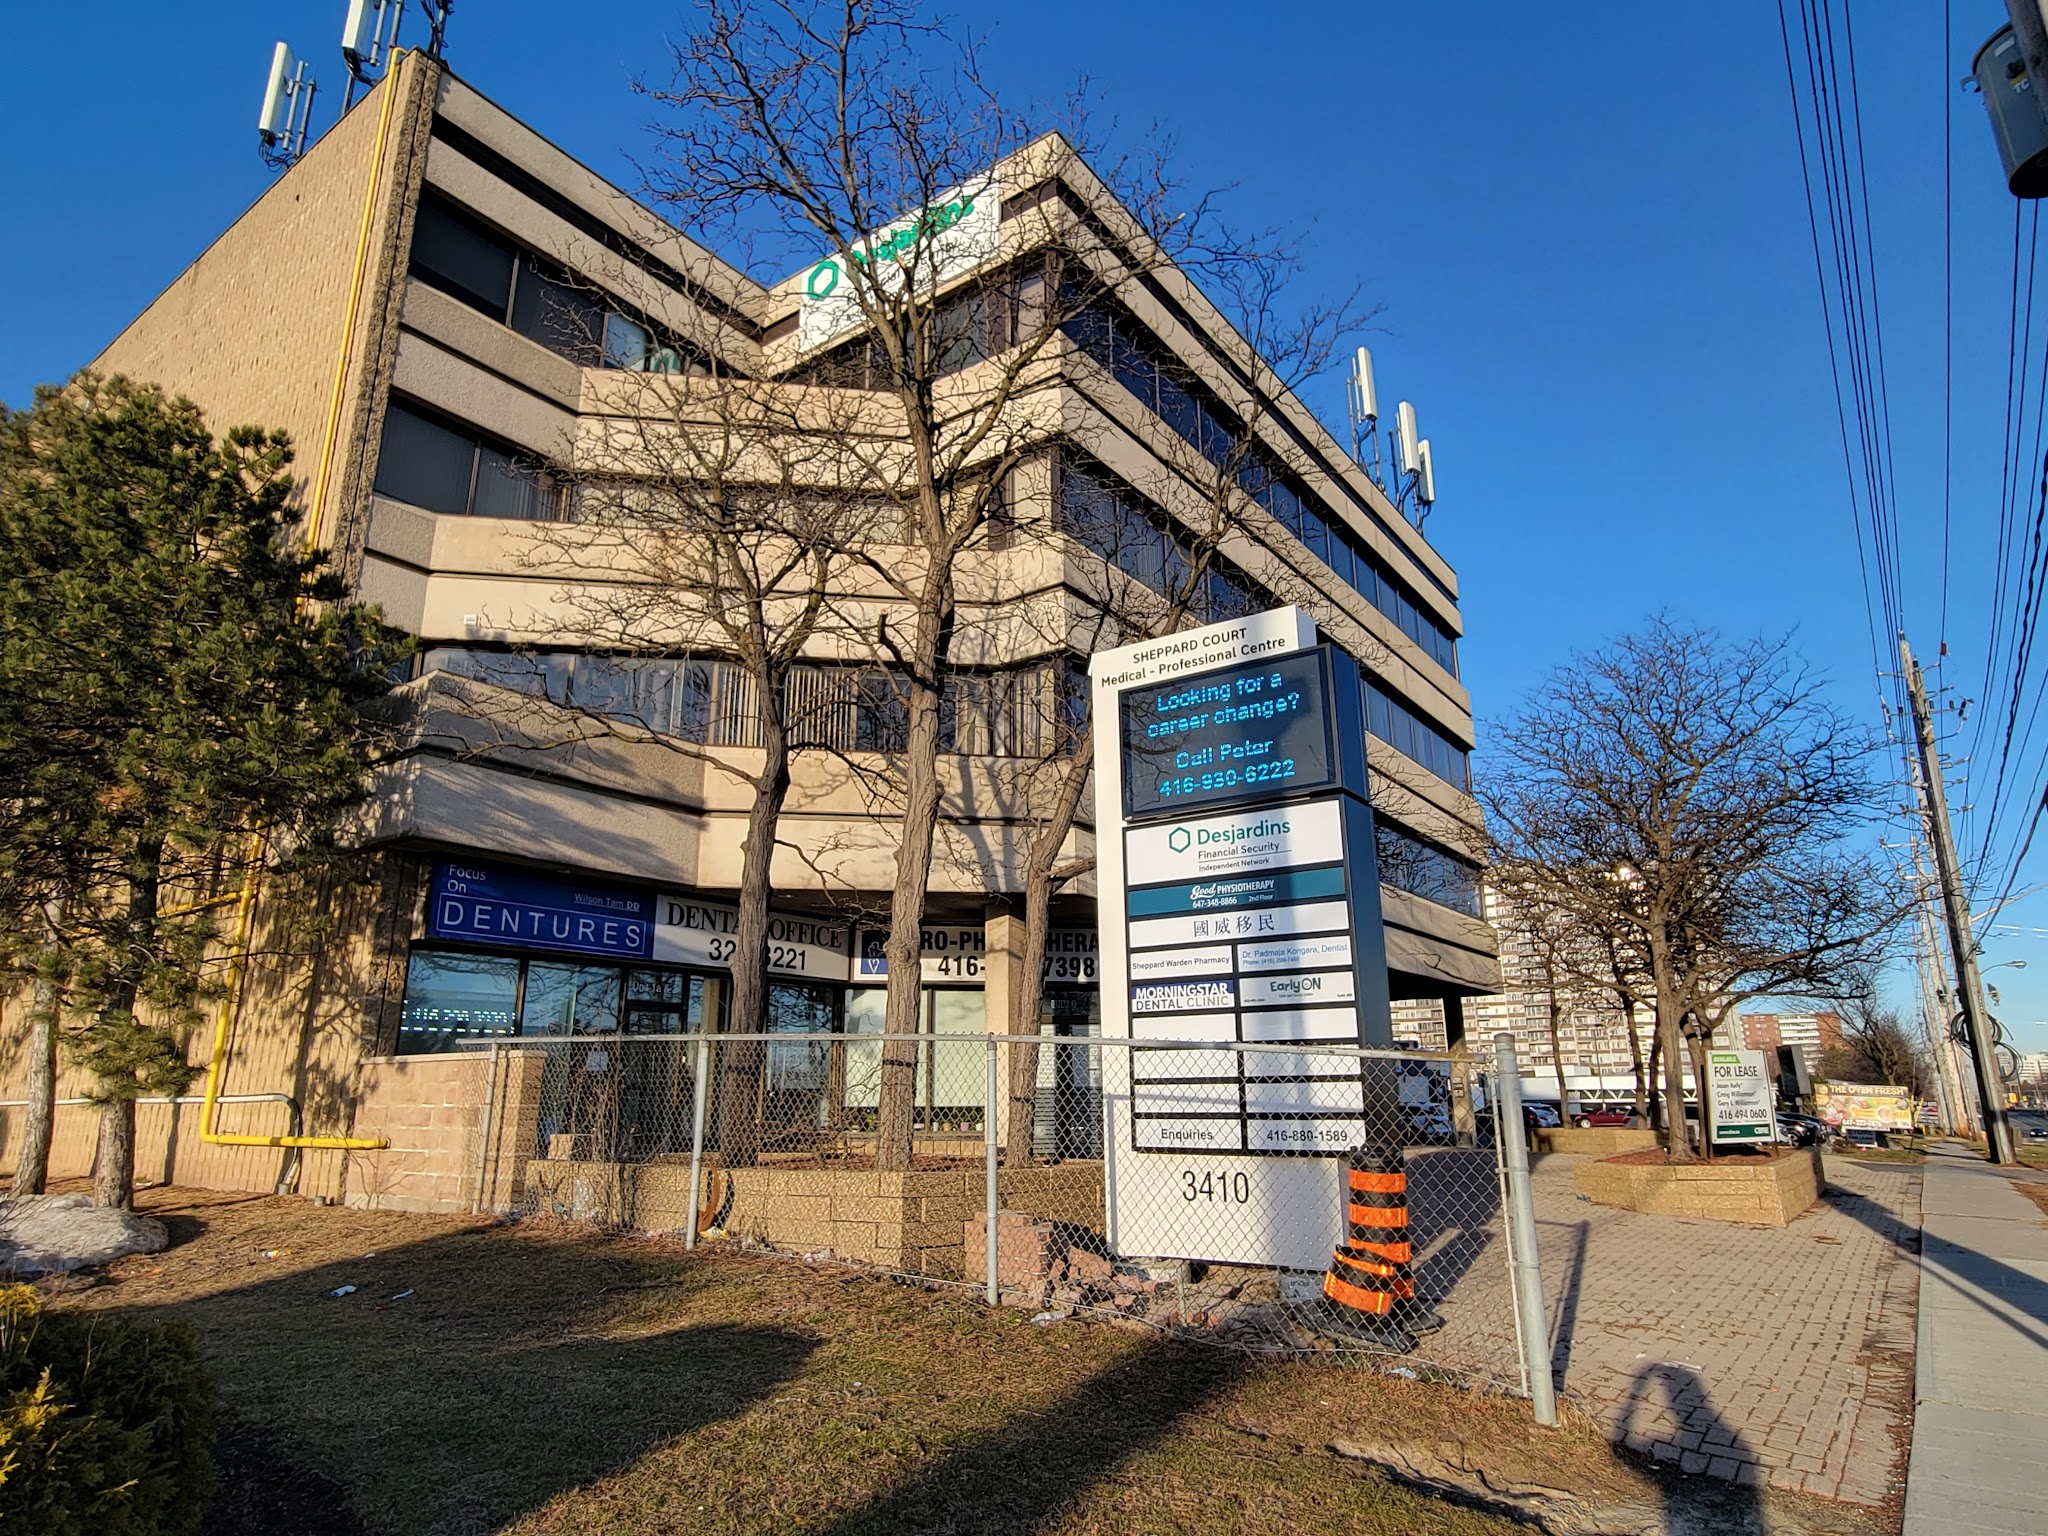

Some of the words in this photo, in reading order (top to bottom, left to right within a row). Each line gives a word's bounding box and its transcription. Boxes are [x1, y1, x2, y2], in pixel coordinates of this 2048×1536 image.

[1133, 639, 1198, 664] SHEPPARD
[1202, 628, 1247, 648] COURT
[1101, 668, 1146, 688] Medical
[1158, 646, 1237, 674] Professional
[1241, 636, 1286, 656] Centre
[1157, 682, 1231, 712] Looking
[1236, 674, 1265, 695] for
[1270, 672, 1282, 688] a
[1147, 711, 1209, 738] career
[1214, 692, 1300, 725] change?
[1176, 747, 1214, 769] Call
[1220, 740, 1274, 762] Peter
[1159, 758, 1296, 797] 416-930-6222
[1197, 819, 1290, 845] Desjardins
[1198, 846, 1239, 860] Financial
[1241, 841, 1280, 856] Security
[449, 864, 486, 881] Focus
[1198, 860, 1240, 872] Independent
[1242, 857, 1270, 868] Network
[447, 880, 467, 894] On
[1190, 883, 1216, 900] Good
[1217, 879, 1274, 894] PHYSIOTHERAPY
[574, 892, 603, 905] Wilson
[605, 897, 624, 908] Tam
[626, 901, 640, 910] DD
[1192, 896, 1238, 908] 647-348-8866
[444, 900, 641, 948] DENTURES
[768, 918, 842, 948] OFFICE
[1194, 914, 1274, 938] 國威移民
[1242, 950, 1252, 958] Dr.
[1322, 944, 1348, 952] Dentist
[1132, 960, 1164, 970] Sheppard
[1166, 958, 1192, 967] Warden
[1194, 955, 1230, 966] Pharmacy
[1136, 982, 1228, 1000] MORNINGSTAR
[1270, 977, 1321, 993] EarlyON
[1136, 1000, 1183, 1011] DENTAL
[1186, 996, 1229, 1007] CLINIC
[1714, 1066, 1732, 1078] FOR
[1734, 1066, 1758, 1076] LEASE
[1830, 1085, 1847, 1094] THE
[1848, 1086, 1873, 1094] OVEN
[1874, 1086, 1904, 1096] FRESH
[1718, 1110, 1733, 1120] 416
[1734, 1109, 1748, 1118] 494
[1750, 1108, 1767, 1118] 0600
[1161, 1128, 1213, 1142] Enquiries
[1266, 1129, 1348, 1142] 416-880-1589
[1182, 1170, 1249, 1204] 3410
